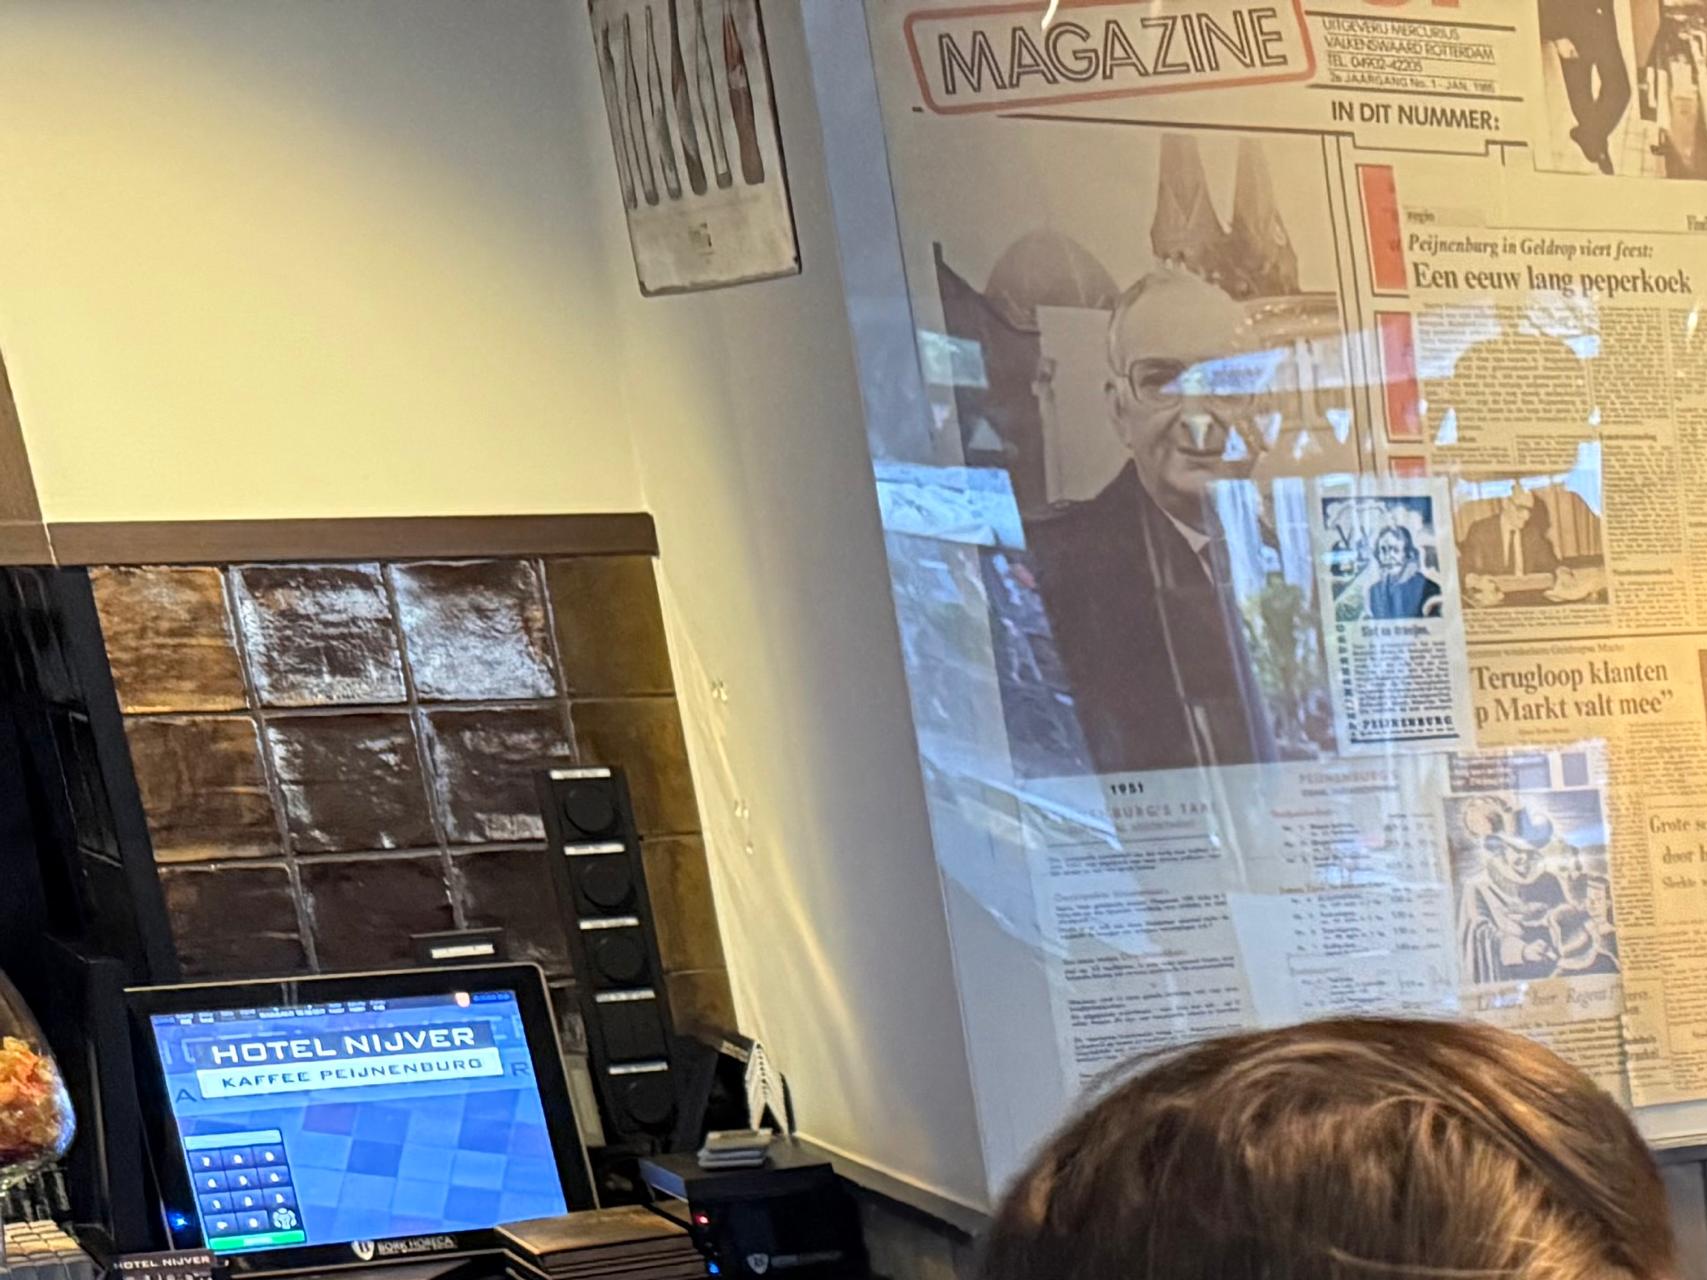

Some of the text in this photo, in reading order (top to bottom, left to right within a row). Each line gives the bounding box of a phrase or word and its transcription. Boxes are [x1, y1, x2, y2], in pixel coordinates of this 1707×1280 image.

[938, 7, 1288, 95] MAGAZINE
[1331, 100, 1501, 131] IN DIT NUMMER:
[1408, 234, 1654, 261] Peijnenburg in Geldrop viert feest:
[1412, 262, 1693, 298] Een eeuw lang peperkoek
[1472, 661, 1669, 692] Terugloop klanten
[1495, 697, 1567, 723] Markt
[1574, 690, 1614, 717] valt
[1111, 782, 1145, 795] 1951
[1650, 815, 1690, 834] Grote
[211, 1025, 477, 1065] HOTEL NIJVER
[222, 1057, 484, 1090] KAFFEE PEIJNENBURG
